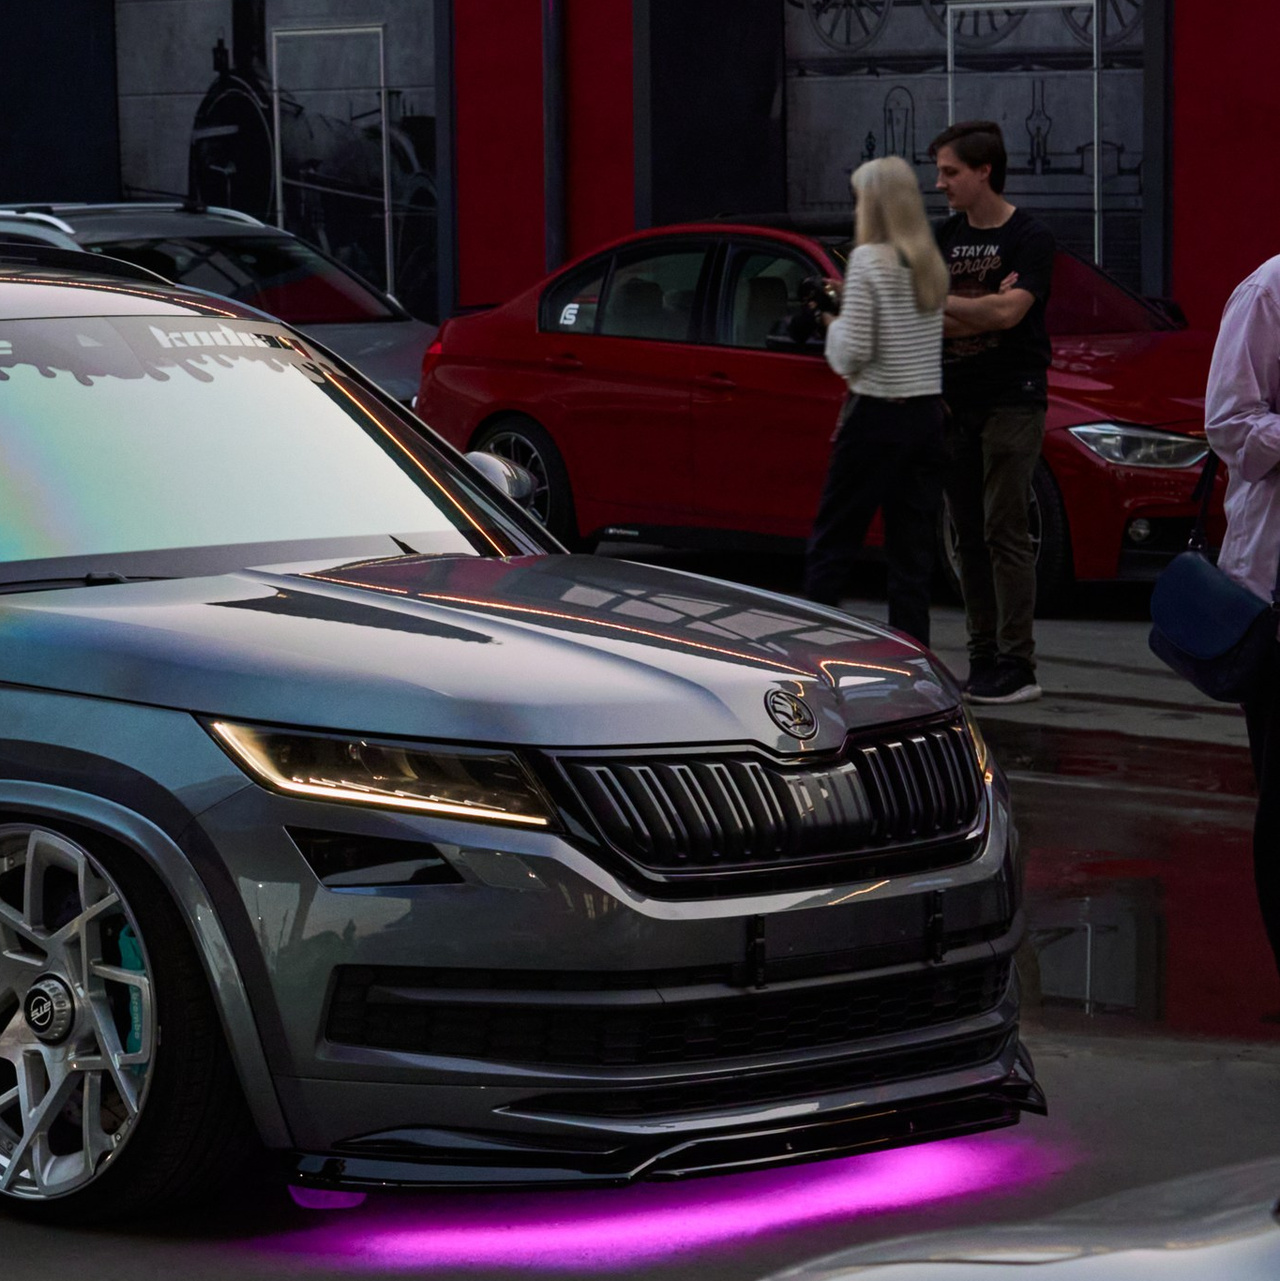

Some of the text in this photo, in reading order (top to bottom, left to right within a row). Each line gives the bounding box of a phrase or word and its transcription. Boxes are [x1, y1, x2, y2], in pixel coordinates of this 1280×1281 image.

[952, 245, 999, 258] STAY IN
[948, 255, 1002, 282] arage
